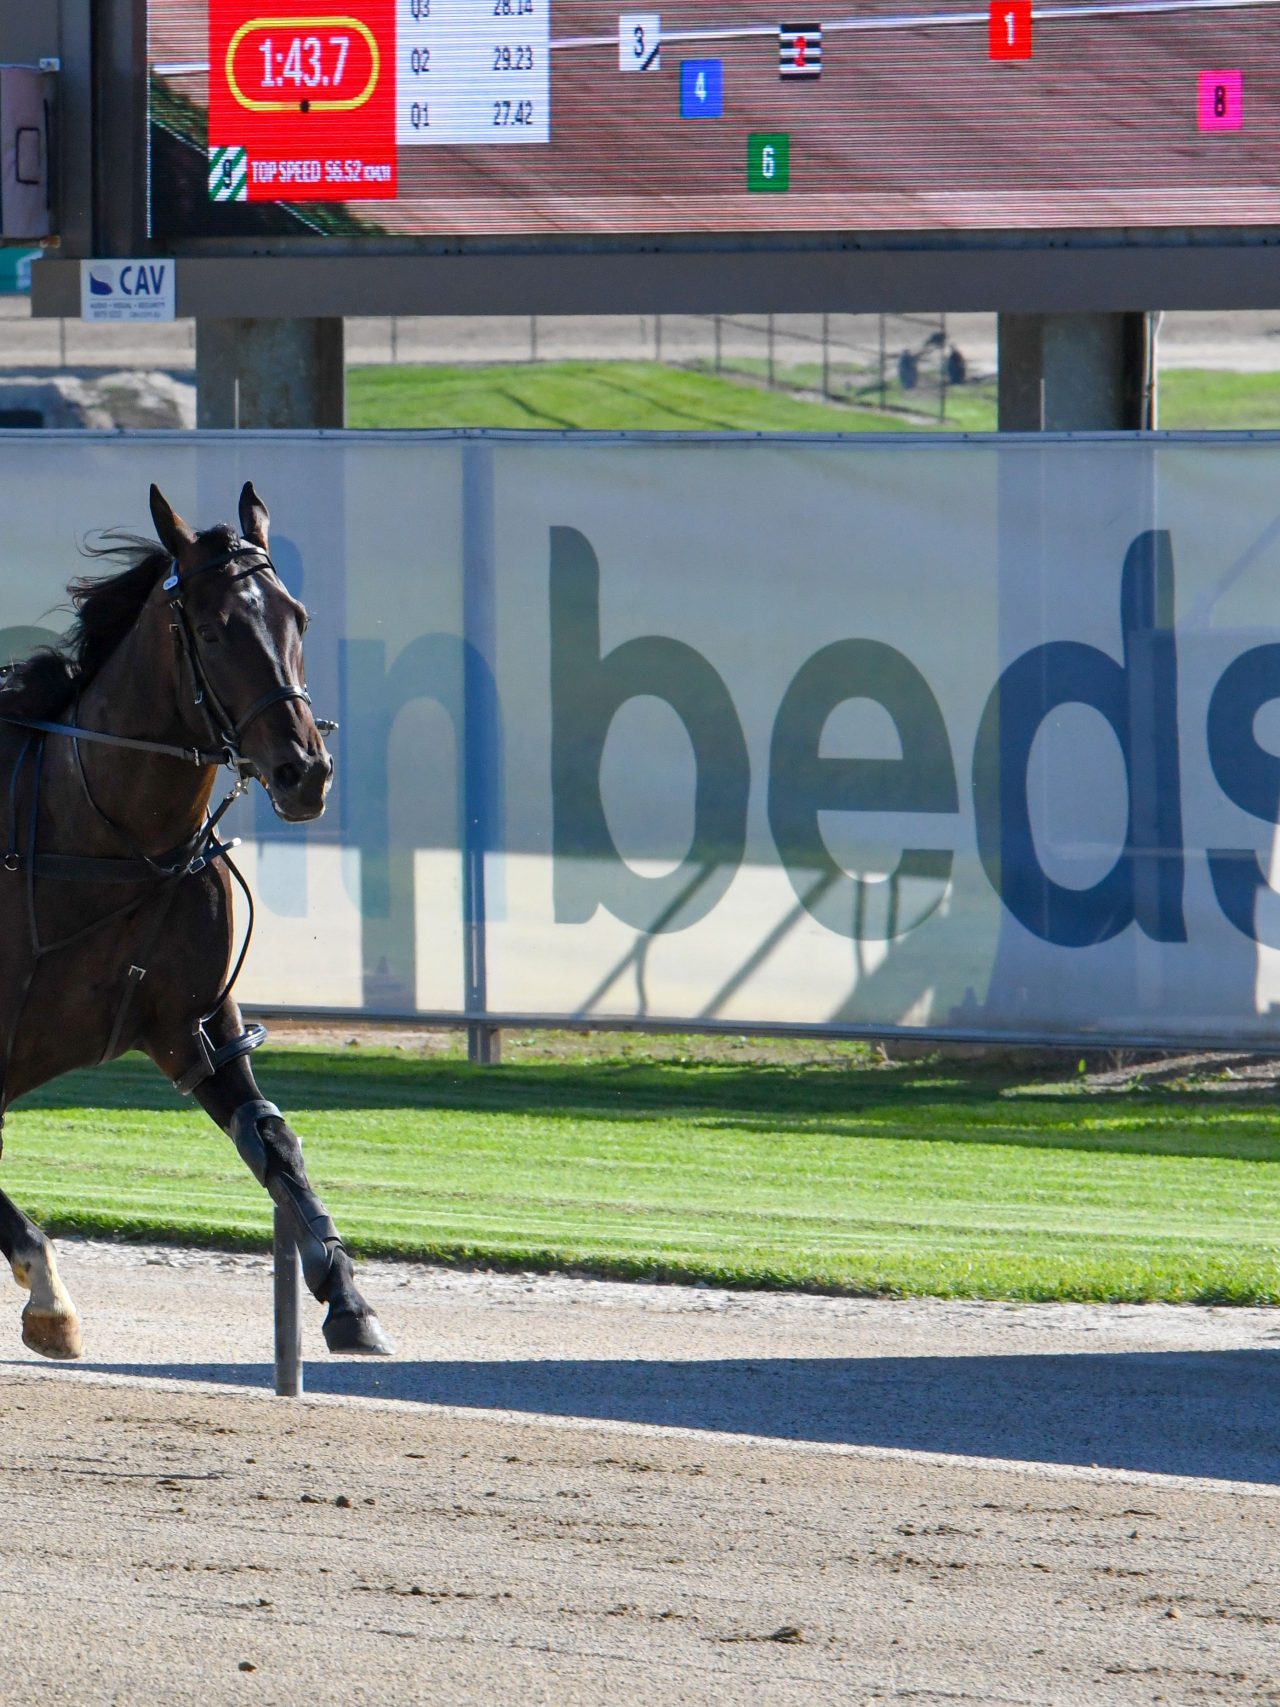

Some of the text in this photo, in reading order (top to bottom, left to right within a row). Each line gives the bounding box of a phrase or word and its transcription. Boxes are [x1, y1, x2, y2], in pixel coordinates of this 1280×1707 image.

[411, 0, 430, 21] Q3
[493, 0, 533, 16] 28.14
[633, 25, 645, 58] 3
[1005, 12, 1016, 46] 1
[259, 37, 349, 88] 1:43.7
[411, 48, 430, 75] Q2
[493, 46, 533, 71] 29.23
[693, 71, 708, 102] 4
[1213, 85, 1227, 118] 8
[411, 102, 430, 129] Q1
[493, 100, 533, 125] 27.42
[223, 159, 233, 189] 9
[251, 161, 277, 183] TOP
[279, 160, 321, 183] SPEED
[325, 160, 362, 182] 56.52
[761, 145, 775, 179] 6
[119, 265, 166, 295] CAV
